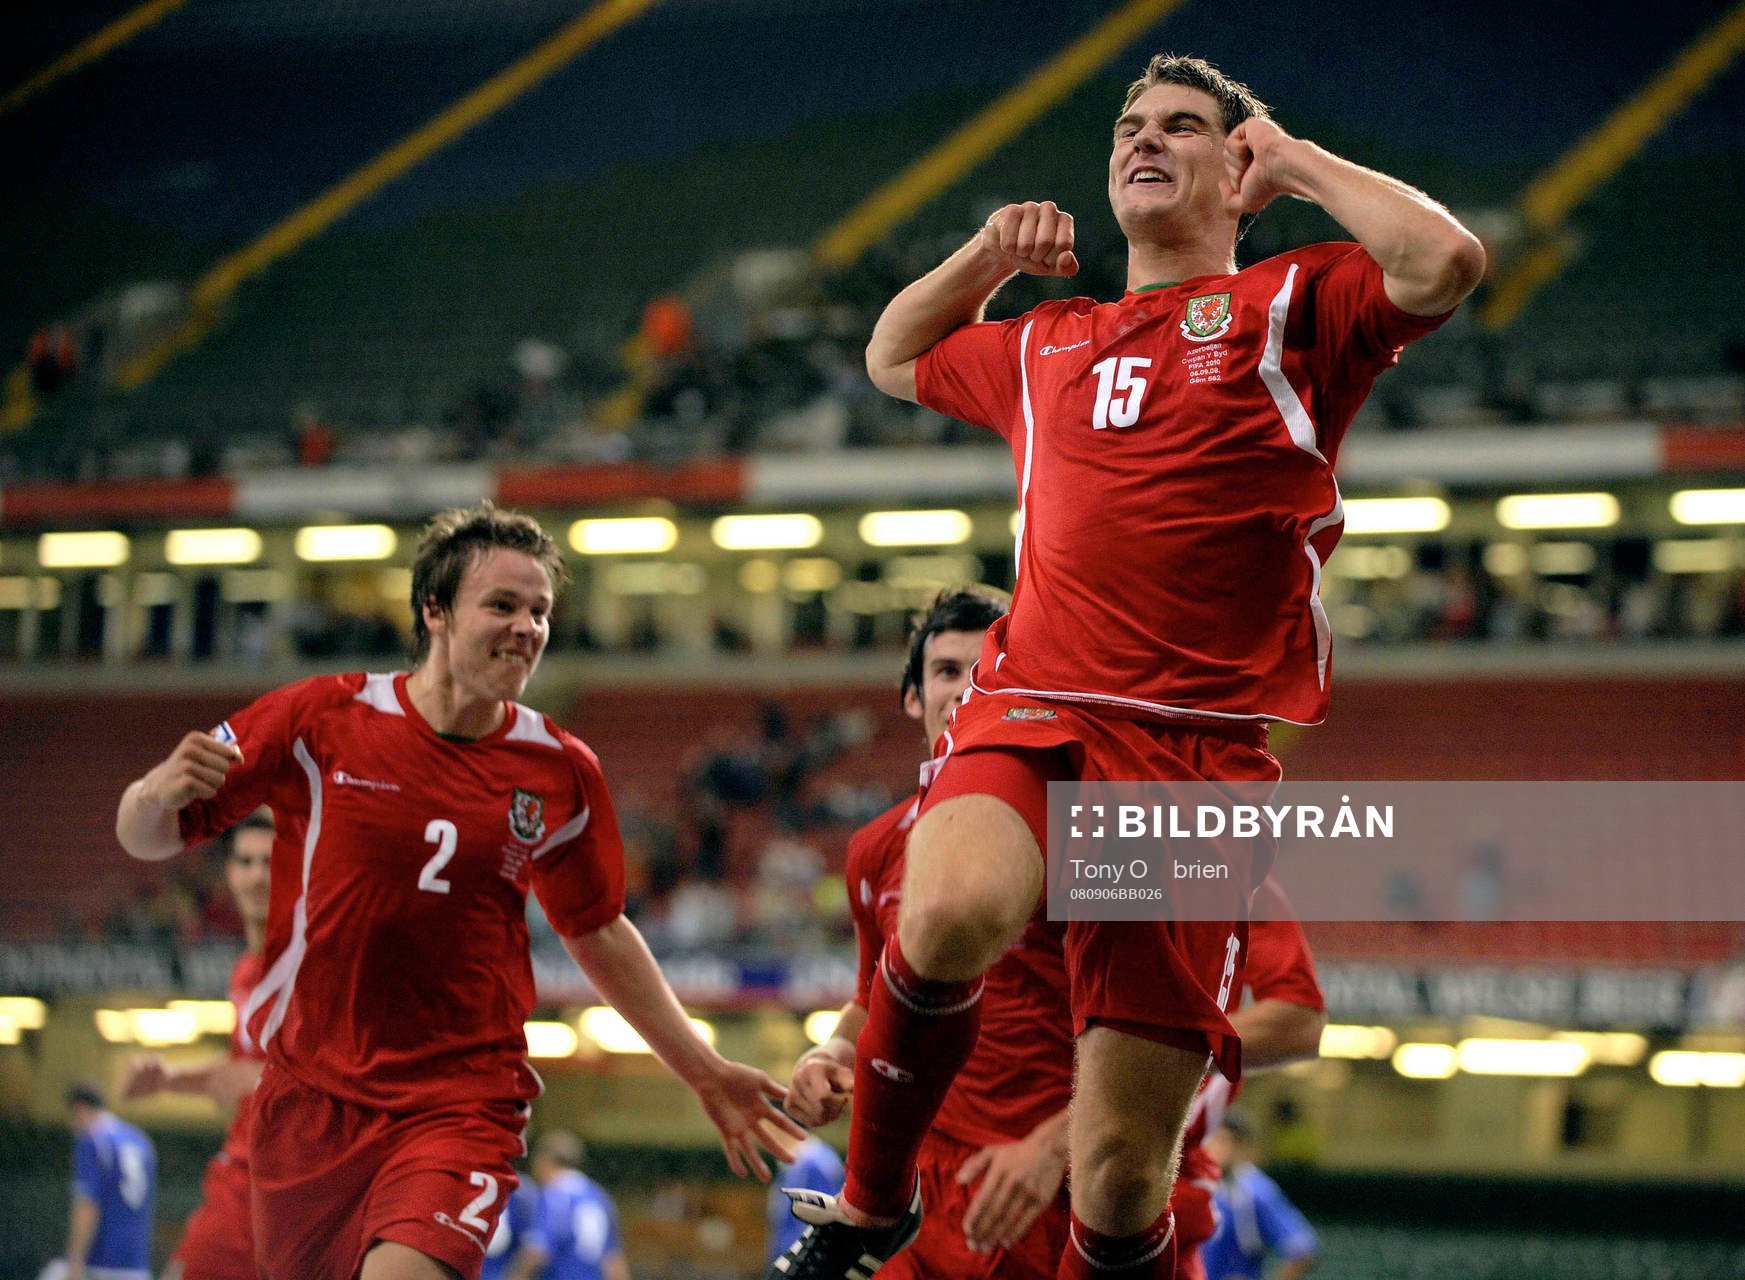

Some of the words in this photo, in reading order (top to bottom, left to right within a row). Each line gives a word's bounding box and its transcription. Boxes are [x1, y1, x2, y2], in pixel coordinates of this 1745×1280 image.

[1039, 339, 1091, 356] Champion
[1187, 343, 1221, 355] Azerbaijan
[1213, 350, 1227, 358] Byd
[1206, 359, 1220, 367] 2010
[1092, 356, 1152, 430] 15
[417, 818, 458, 894] 2
[458, 1171, 499, 1233] 2
